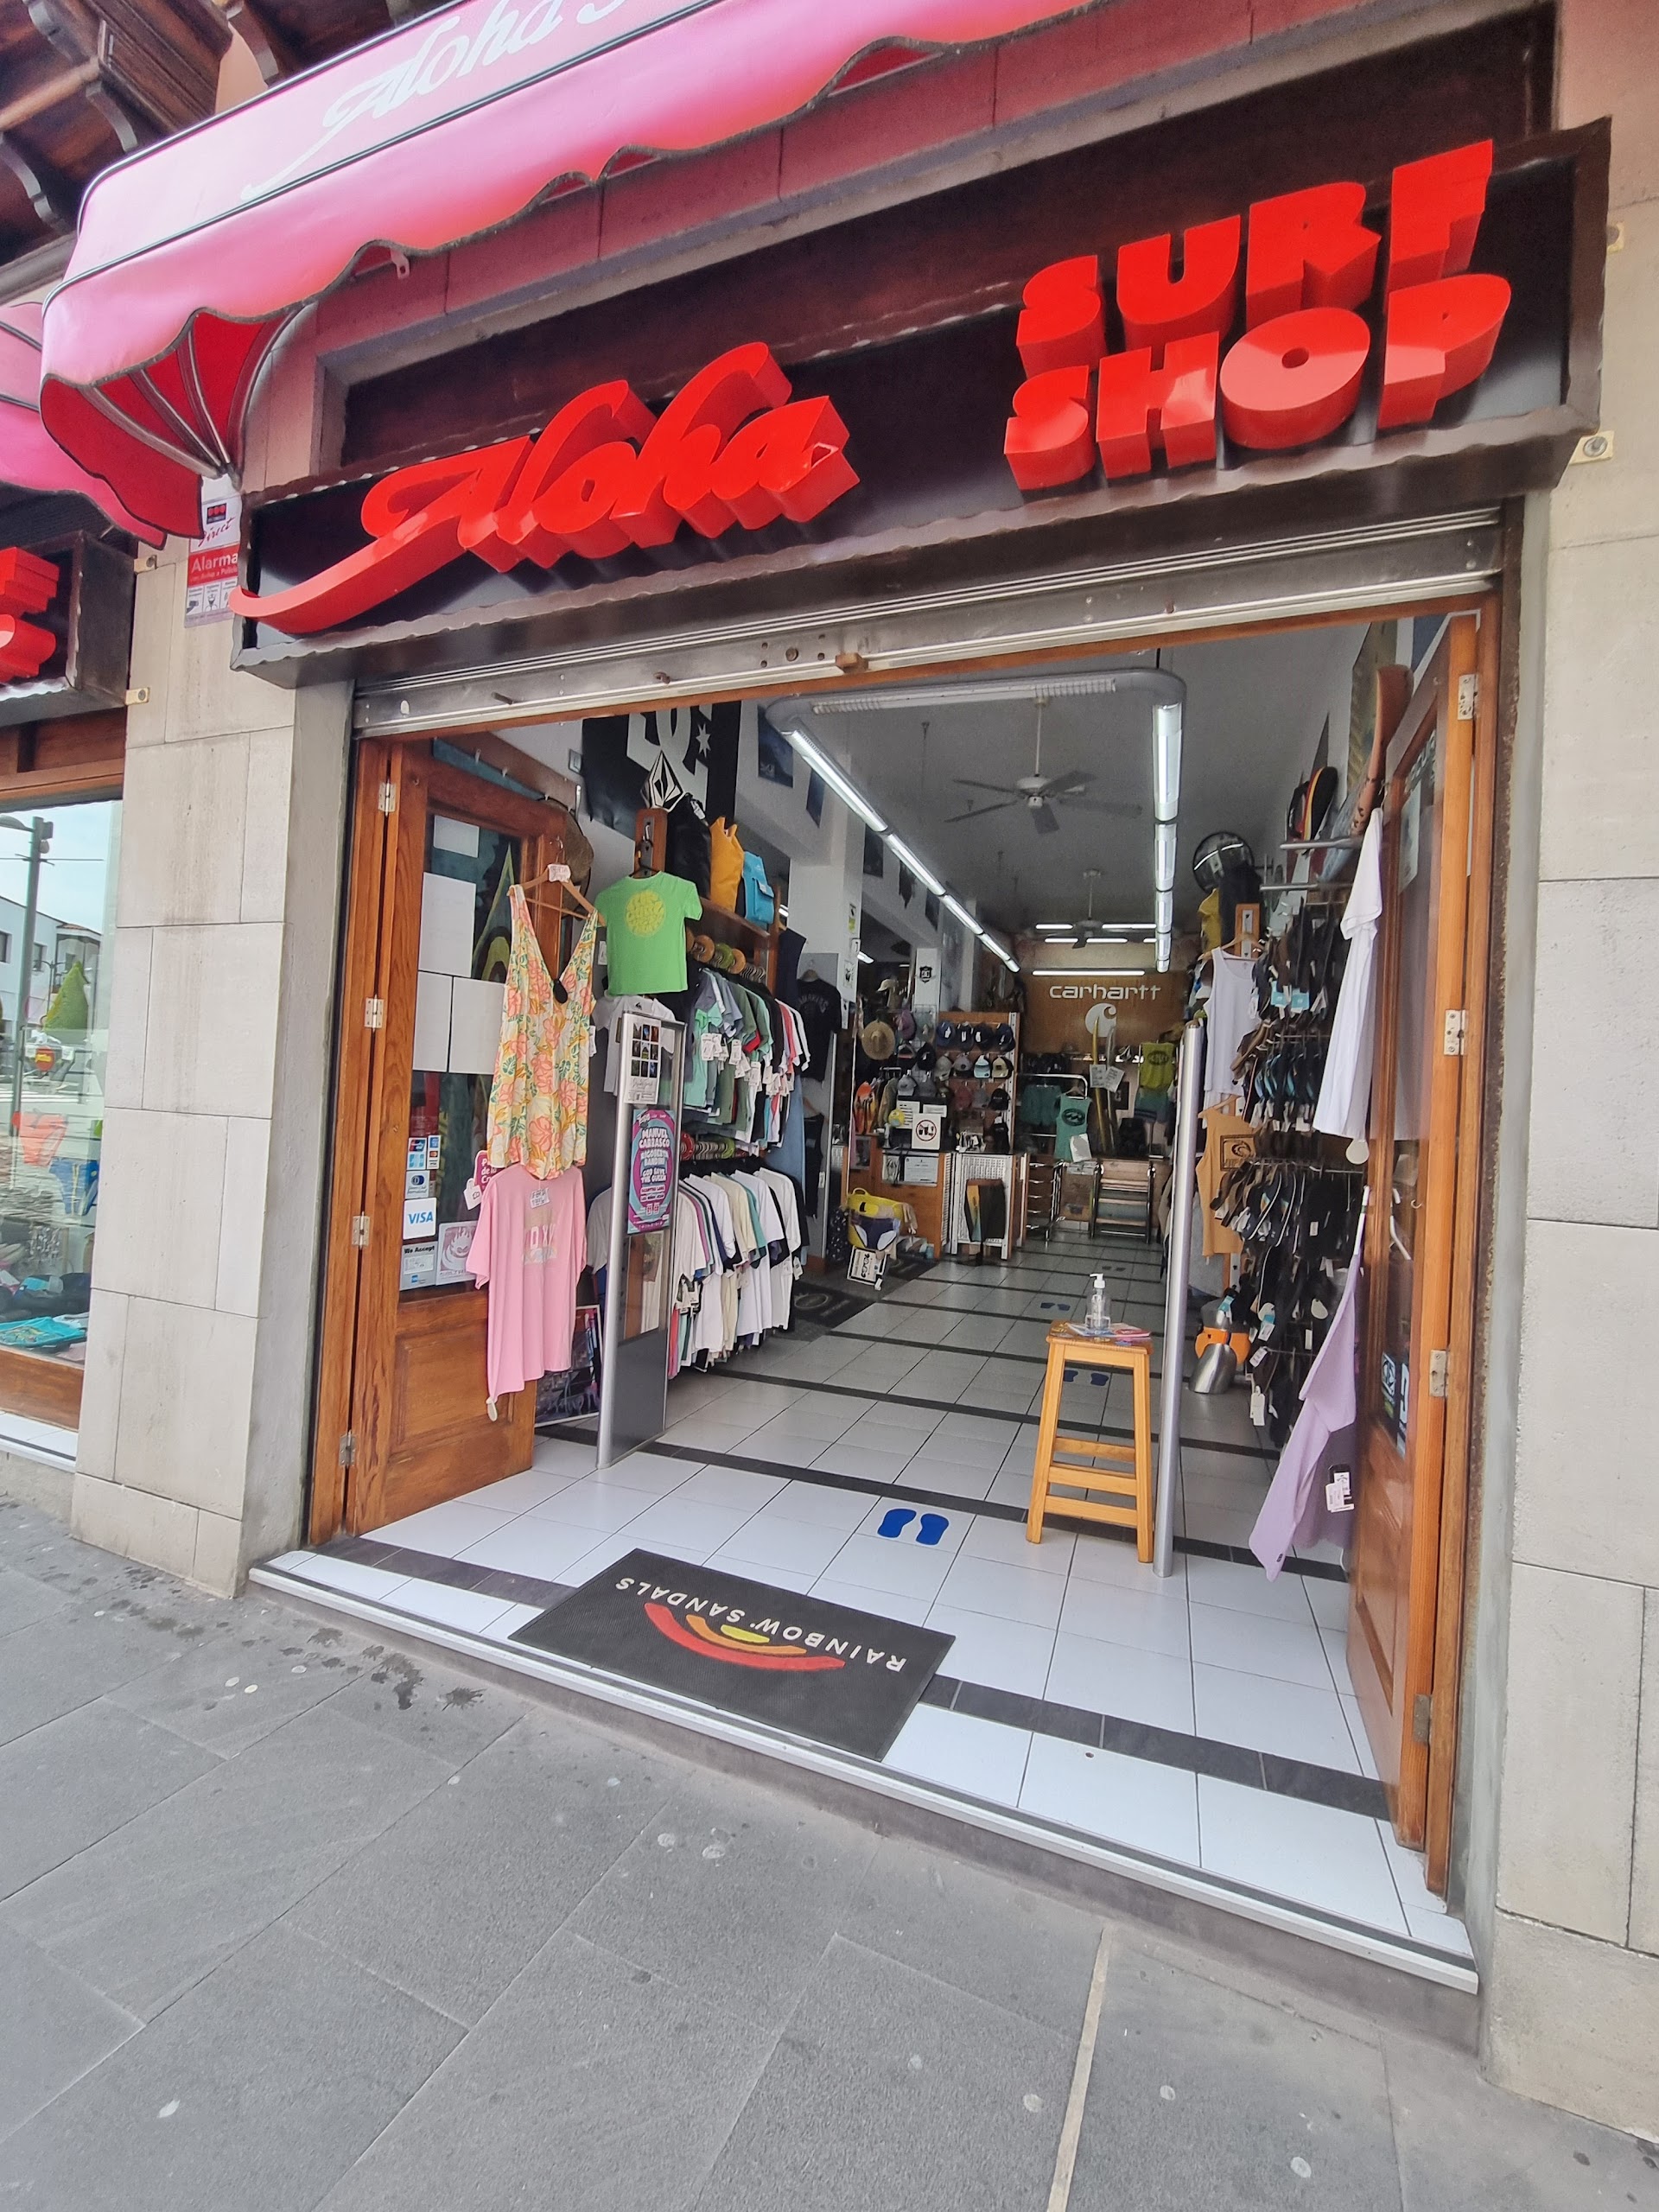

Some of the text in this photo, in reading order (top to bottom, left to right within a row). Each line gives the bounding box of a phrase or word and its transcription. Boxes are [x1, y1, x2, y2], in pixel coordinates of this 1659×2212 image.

[1016, 139, 1493, 367] SURF
[1004, 273, 1512, 486] SHOP
[228, 342, 859, 631] Aloha
[191, 552, 238, 574] Alarma
[1049, 983, 1161, 1001] carhartt
[408, 1211, 434, 1224] VISA
[615, 1576, 746, 1623] SANDALS
